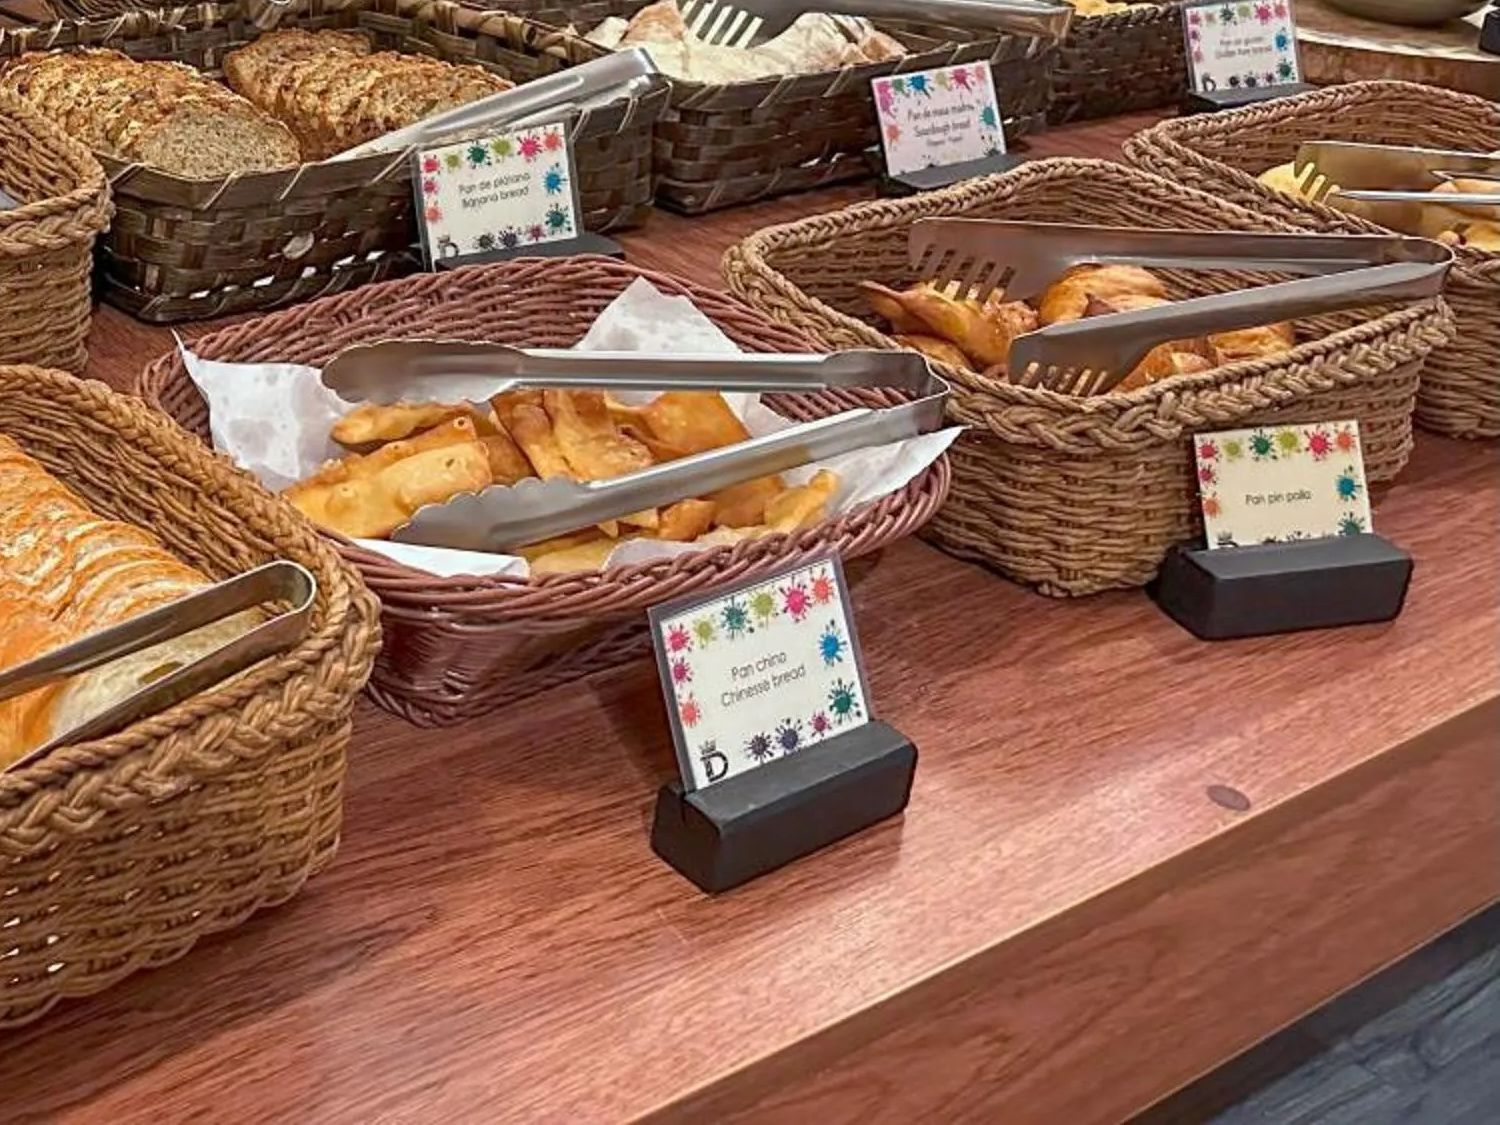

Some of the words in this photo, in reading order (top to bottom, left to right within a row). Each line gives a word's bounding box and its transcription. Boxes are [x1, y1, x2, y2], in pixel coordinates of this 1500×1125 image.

[458, 183, 477, 195] Pan
[479, 180, 491, 191] de
[461, 194, 499, 209] Banana
[500, 185, 530, 200] bread
[1244, 493, 1267, 506] Pan
[731, 662, 755, 682] Pan
[771, 662, 806, 689] bread
